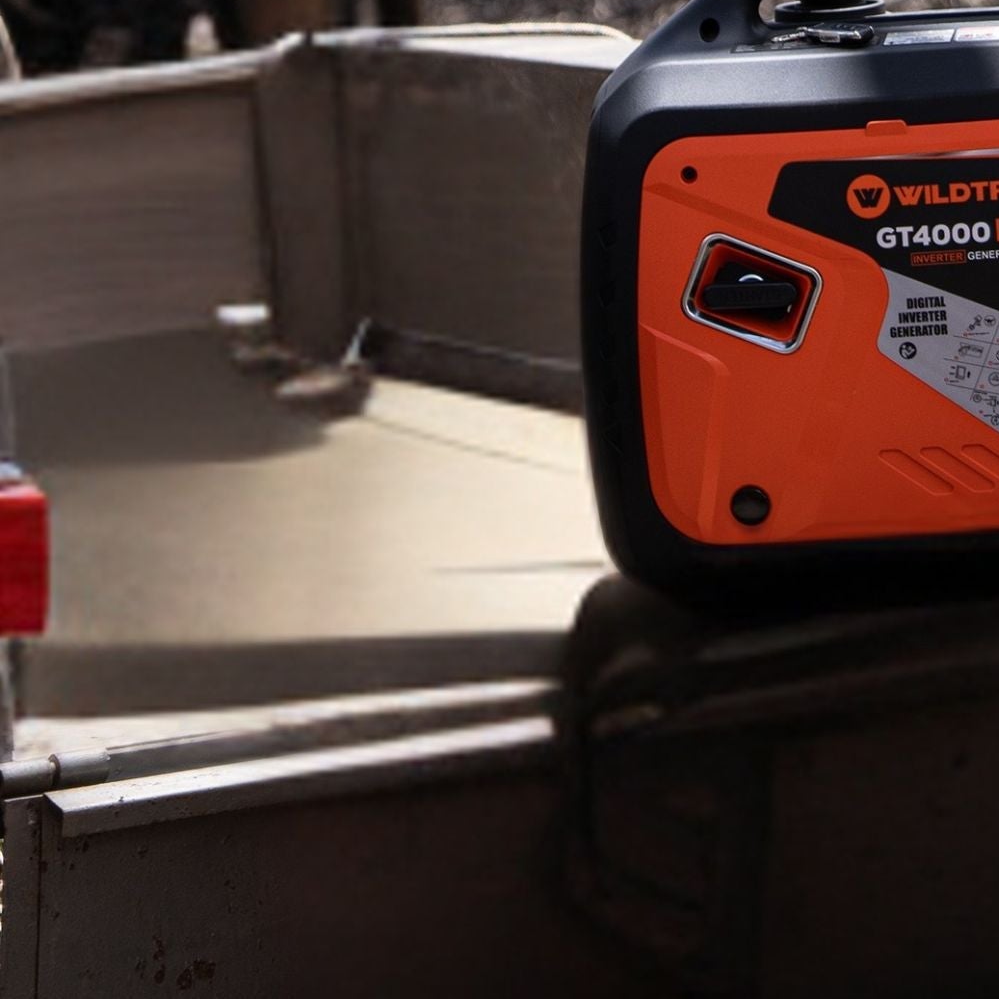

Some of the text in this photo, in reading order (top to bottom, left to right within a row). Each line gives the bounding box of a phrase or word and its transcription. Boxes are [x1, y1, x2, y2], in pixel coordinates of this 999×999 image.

[876, 221, 991, 249] GT4000
[913, 252, 963, 265] INVERTER
[906, 296, 946, 309] DIGITAL
[898, 310, 947, 324] INVERTER
[890, 324, 948, 338] GENERATOR
